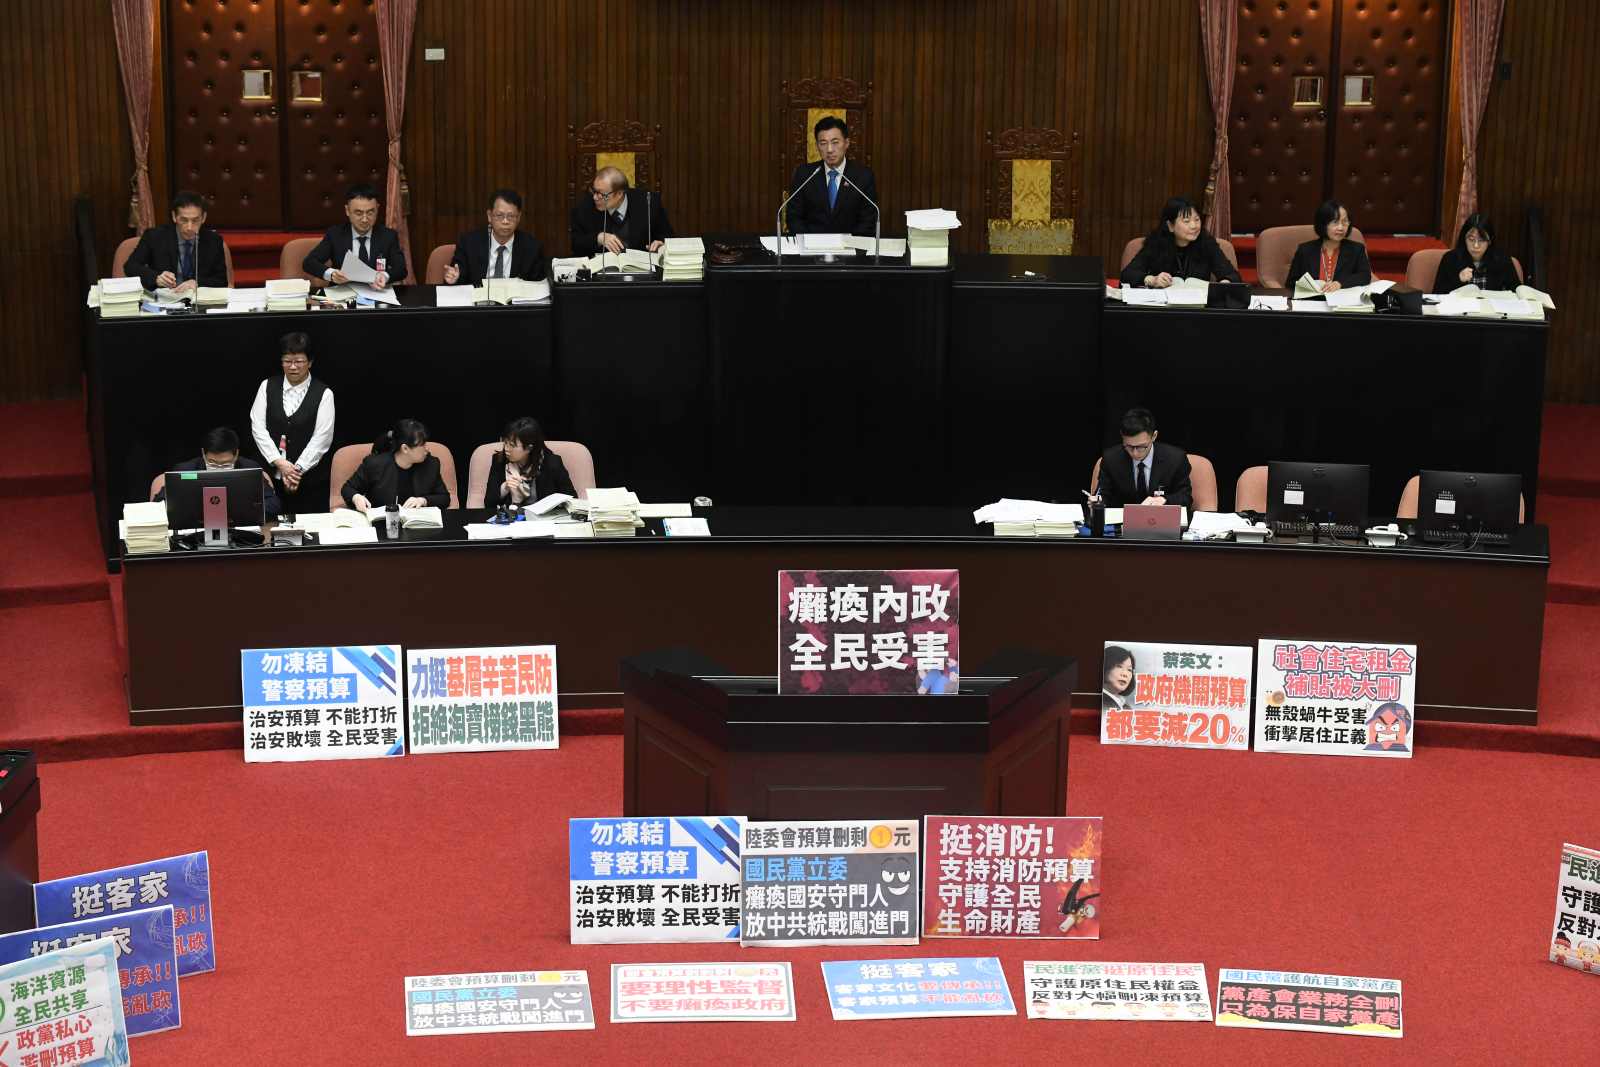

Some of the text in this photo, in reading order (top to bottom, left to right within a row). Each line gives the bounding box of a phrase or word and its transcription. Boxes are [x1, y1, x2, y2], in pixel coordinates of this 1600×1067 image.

[788, 584, 950, 623] 癱瘓內政
[261, 652, 328, 675] 勿凍結
[789, 631, 949, 671] 全民受害
[1275, 645, 1413, 674] 社會住宅租金
[412, 653, 552, 698] 力挺基層辛苦民防
[1285, 672, 1400, 700] 補貼被大刪
[261, 678, 351, 702] 警察預算
[1136, 674, 1246, 708] 政府機關預算
[250, 706, 398, 728] 治安預算 不能打折
[1106, 709, 1246, 744] 都要減20%
[1265, 705, 1367, 725] 無殼蝸牛受害
[251, 727, 398, 750] 治安敗壞 全民受害
[1264, 725, 1367, 745] 衝擊居住正義
[590, 821, 664, 846] 勿凍結
[939, 822, 1054, 857] 挺消防!
[590, 850, 689, 876] 警察預算
[745, 856, 848, 881] 國民黨立委
[939, 857, 1094, 883] 支持消防預算
[72, 871, 169, 919] 挺客家
[576, 884, 740, 904] 治安預算 不能打折
[745, 883, 889, 909] 癱瘓國安守門人
[938, 883, 1041, 908] 守護全民
[576, 907, 740, 928] 治安敗壞 全民受害
[745, 910, 909, 937] 放中共統戰闖進門
[937, 909, 1040, 934] 生命財產
[1557, 912, 1600, 939] 反對
[11, 964, 86, 1002] 海洋資源
[860, 962, 960, 979] 挺客家
[412, 987, 518, 1003] 國民黨立委
[621, 979, 784, 996] 要理性監督
[1031, 978, 1201, 991] 守護原住民權益
[1032, 990, 1203, 1003] 反對大幅刪凍預算
[14, 989, 88, 1027] 全民共享
[621, 998, 785, 1012] 不要癱瘓政府
[1222, 986, 1399, 1011] 黨產會業務全刪
[16, 1014, 92, 1050] 政黨私心
